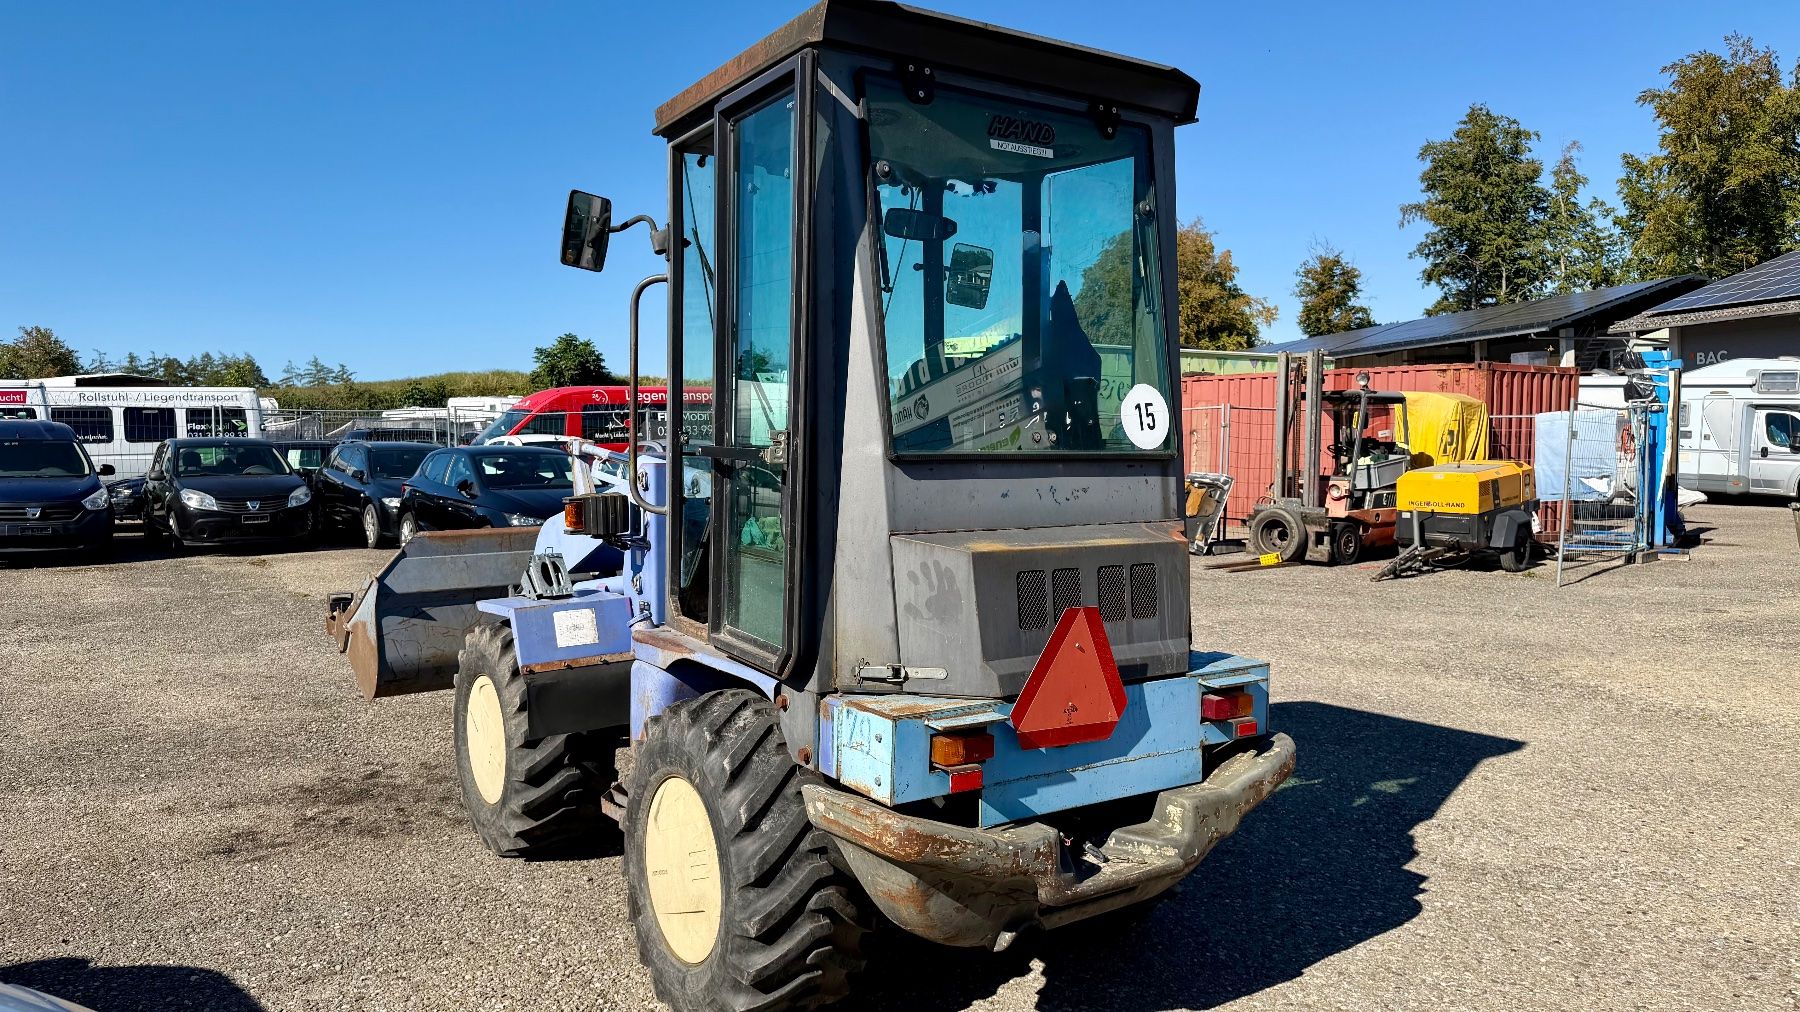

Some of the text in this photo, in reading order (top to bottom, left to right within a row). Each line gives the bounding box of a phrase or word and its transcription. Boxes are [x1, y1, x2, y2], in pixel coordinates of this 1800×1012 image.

[989, 115, 1055, 145] HAND
[144, 392, 239, 403] Liegendtransport
[1134, 402, 1156, 431] 15
